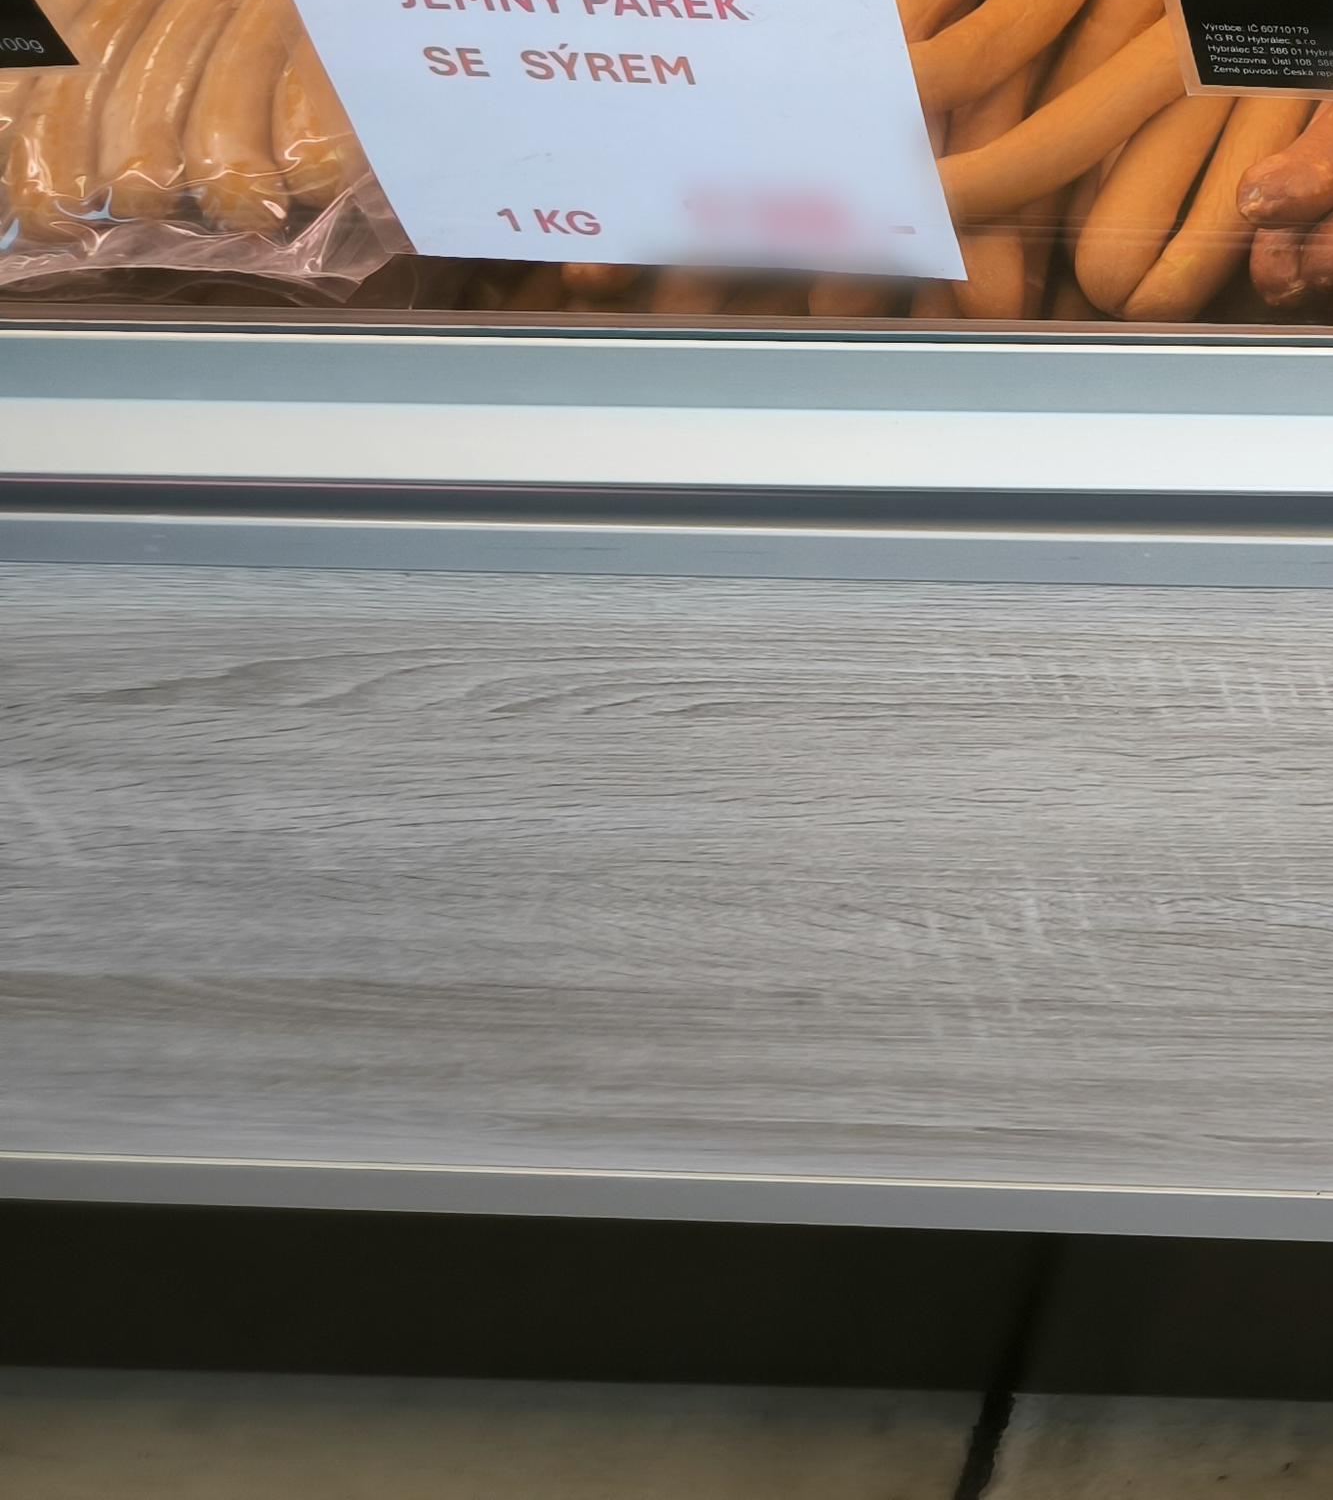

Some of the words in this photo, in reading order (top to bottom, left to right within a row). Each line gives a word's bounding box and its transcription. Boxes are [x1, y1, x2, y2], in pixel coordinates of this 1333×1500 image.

[422, 44, 491, 78] SE
[520, 41, 697, 86] SÝREM
[497, 207, 523, 234] 1
[534, 207, 602, 237] KG
